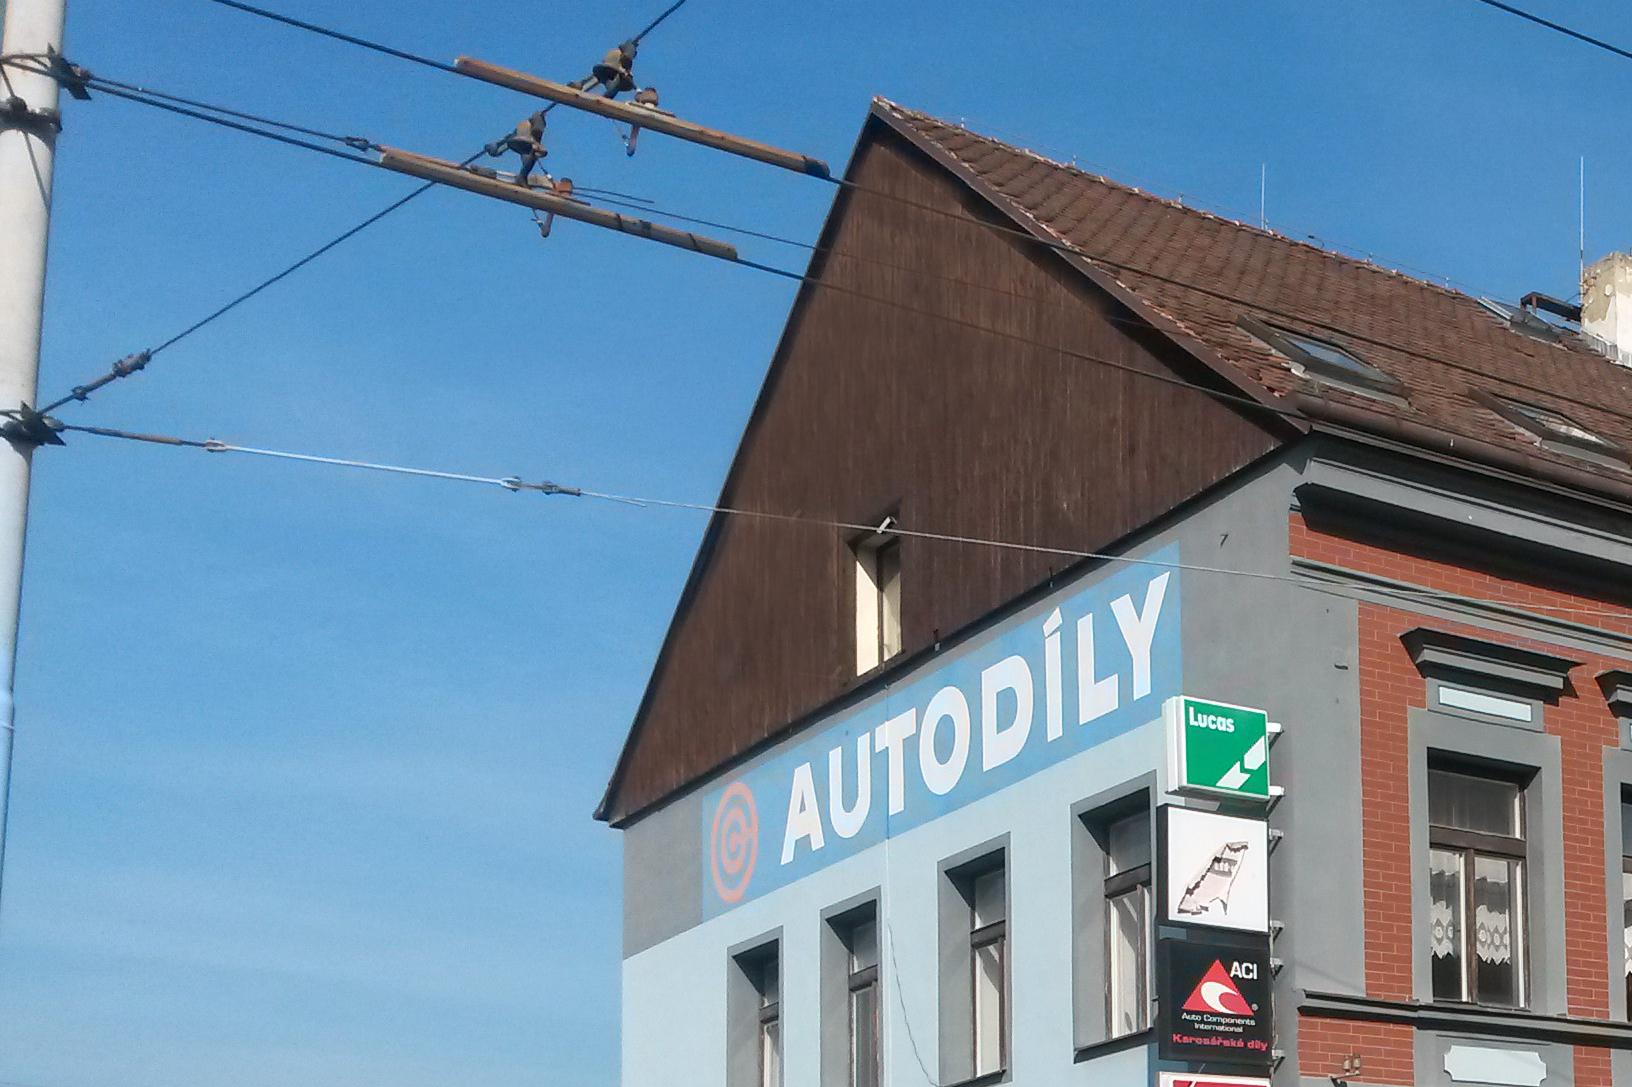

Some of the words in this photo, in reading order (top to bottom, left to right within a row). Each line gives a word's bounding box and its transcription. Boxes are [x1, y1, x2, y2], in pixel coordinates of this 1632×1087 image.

[780, 571, 1171, 866] AUTODÍLY
[1189, 707, 1235, 733] Lucas
[1230, 961, 1258, 980] ACI
[1181, 1012, 1202, 1021] Auto
[1203, 1014, 1256, 1026] Components
[1194, 1023, 1244, 1033] International
[1247, 1039, 1268, 1051] díly
